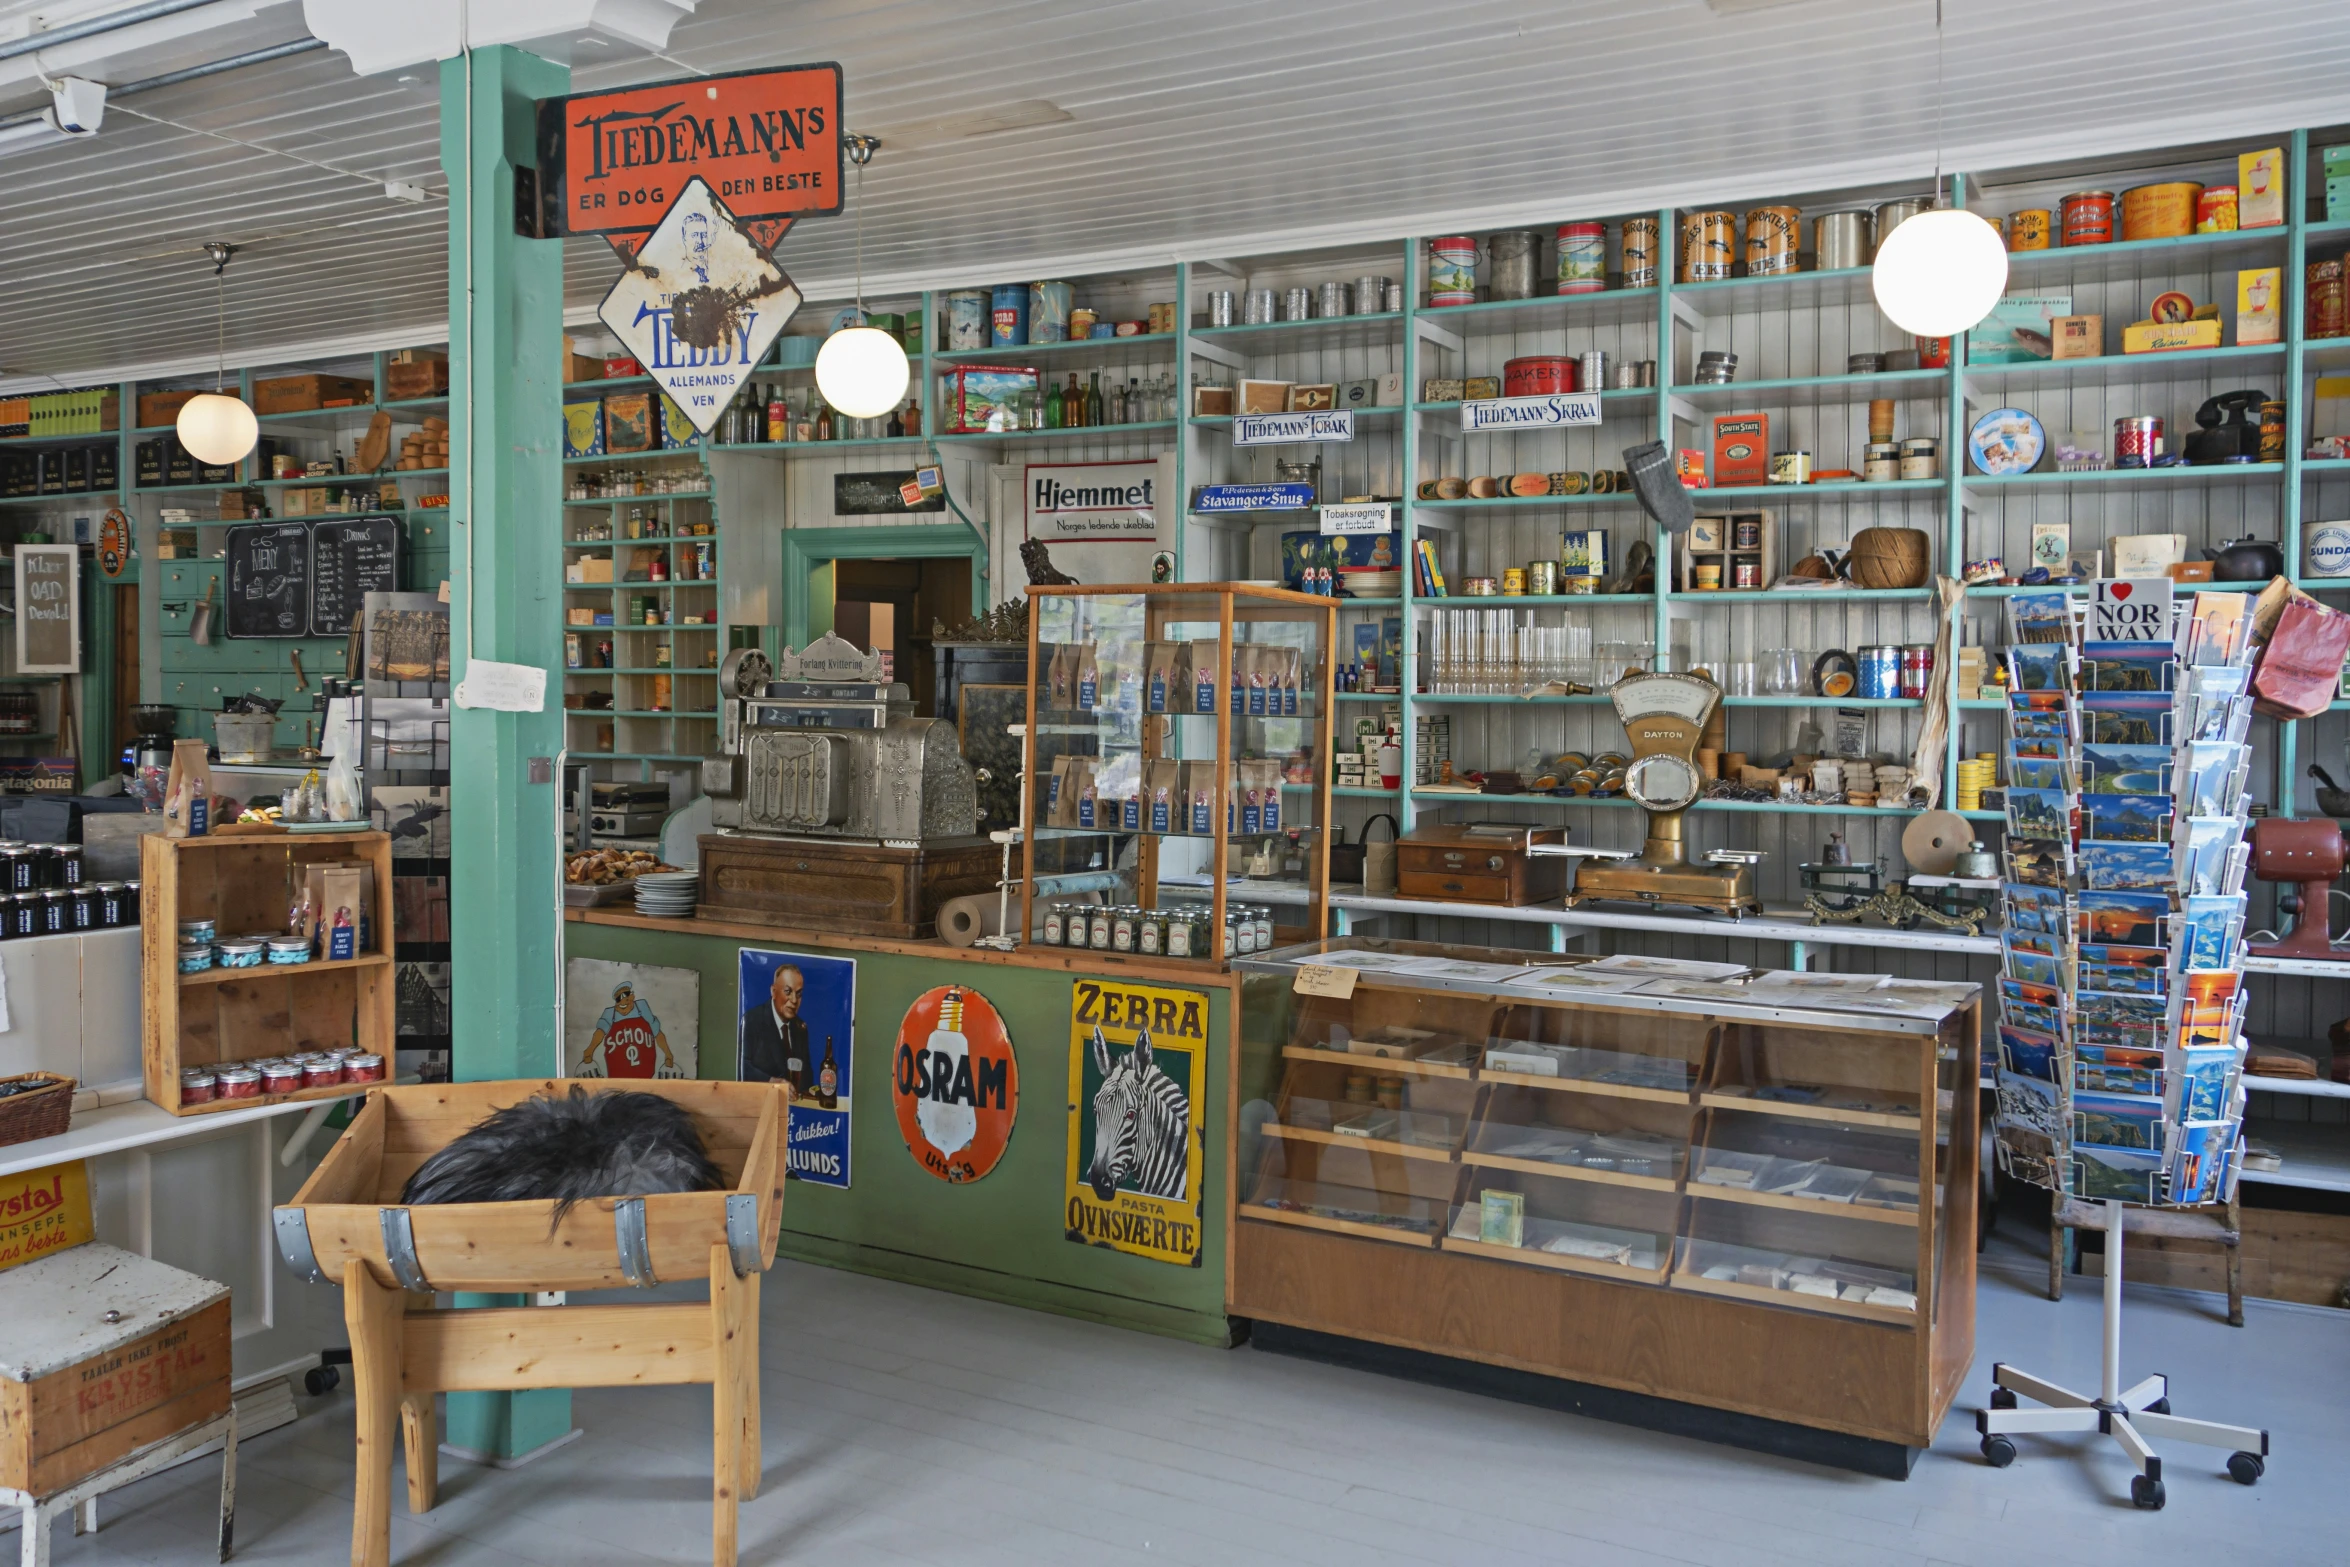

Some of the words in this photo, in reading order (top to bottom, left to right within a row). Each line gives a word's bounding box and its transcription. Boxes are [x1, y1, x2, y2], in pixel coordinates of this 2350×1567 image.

[580, 192, 606, 210] ER
[618, 187, 664, 207] DOG
[722, 178, 755, 197] DEN
[763, 170, 822, 191] BESTE
[2151, 338, 2188, 350] Raisins
[668, 374, 736, 388] ALLEMANDS
[692, 394, 715, 407] VEN
[1466, 400, 1548, 429] TIEDEMANNS
[1547, 397, 1596, 423] SKRAA
[1236, 416, 1309, 442] TIEDEMANNS
[1303, 412, 1351, 439] TOBAK
[1719, 422, 1741, 433] SOUTH
[1740, 422, 1760, 433] STATE
[1035, 478, 1154, 512] Hjemmet
[1201, 492, 1304, 509] Stavanger-Snus
[1325, 508, 1386, 521] Tobaksrøgning
[342, 527, 371, 542] DRINKS
[1056, 519, 1086, 533] Norges
[1089, 519, 1121, 531] ledende
[1123, 517, 1155, 531] ukeblad
[1345, 520, 1376, 530] forbudt
[251, 546, 279, 571] MENY
[2096, 582, 2106, 602] I
[2095, 603, 2162, 624] NOR
[2096, 625, 2163, 641] WAY
[800, 658, 827, 672] Forlang
[828, 659, 863, 674] Kvittering
[1644, 731, 1683, 739] DAYTON
[1075, 983, 1204, 1040] ZEBRA
[606, 1026, 653, 1055] SCHOU
[897, 1043, 1008, 1110] OSRAM
[795, 1117, 840, 1142] drikker!
[1121, 1198, 1165, 1216] PASTA
[1066, 1196, 1194, 1256] OVNSVÆRTE
[25, 1225, 67, 1253] beste
[82, 1357, 123, 1382] TAALER
[128, 1345, 153, 1363] IKKE
[158, 1330, 189, 1351] FROST
[77, 1342, 206, 1416] KRYSTAL
